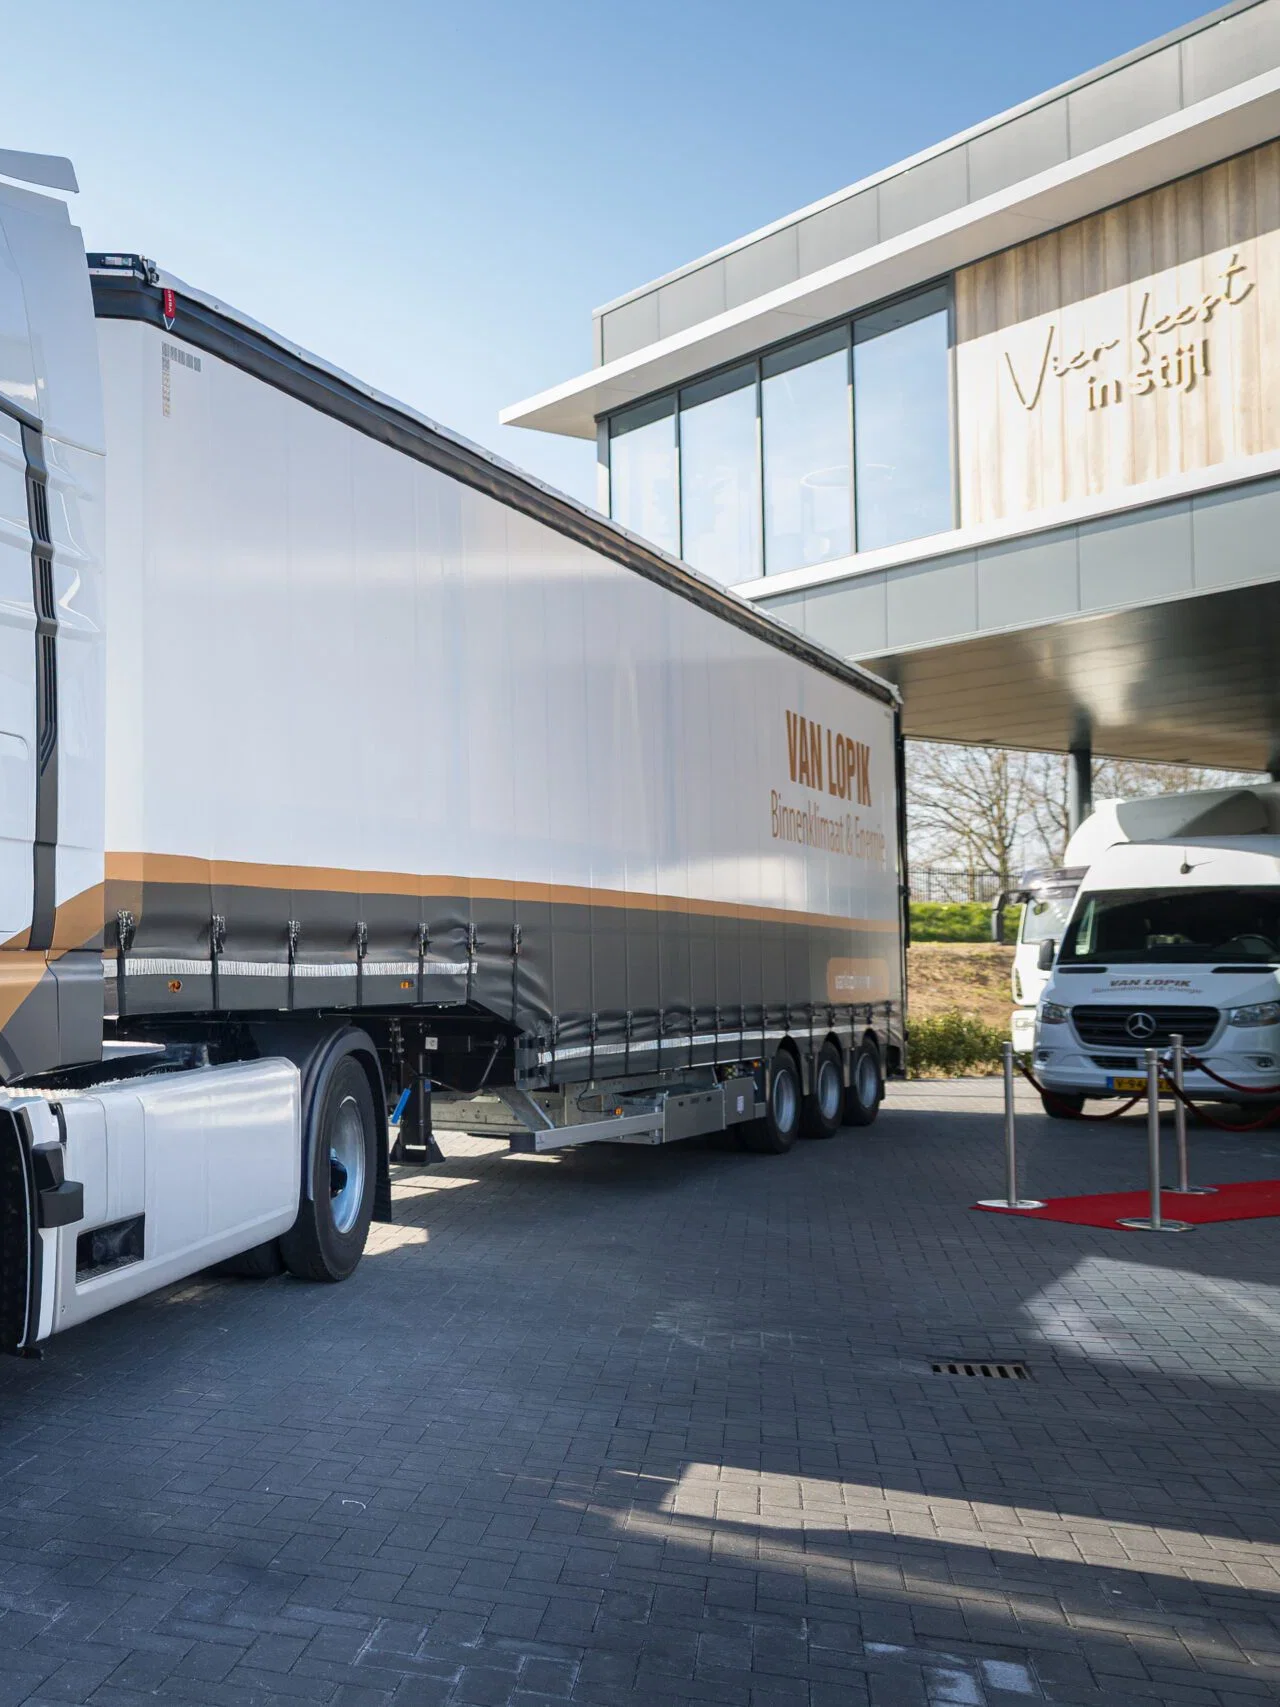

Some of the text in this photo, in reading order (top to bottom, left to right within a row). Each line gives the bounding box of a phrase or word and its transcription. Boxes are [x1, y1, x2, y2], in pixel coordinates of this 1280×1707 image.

[1005, 325, 1120, 410] Vier
[1088, 339, 1212, 411] in stijl
[785, 709, 872, 807] VAN LOPIK
[771, 789, 844, 853] Binnenklimaat
[1110, 978, 1191, 987] VAN LOPIK
